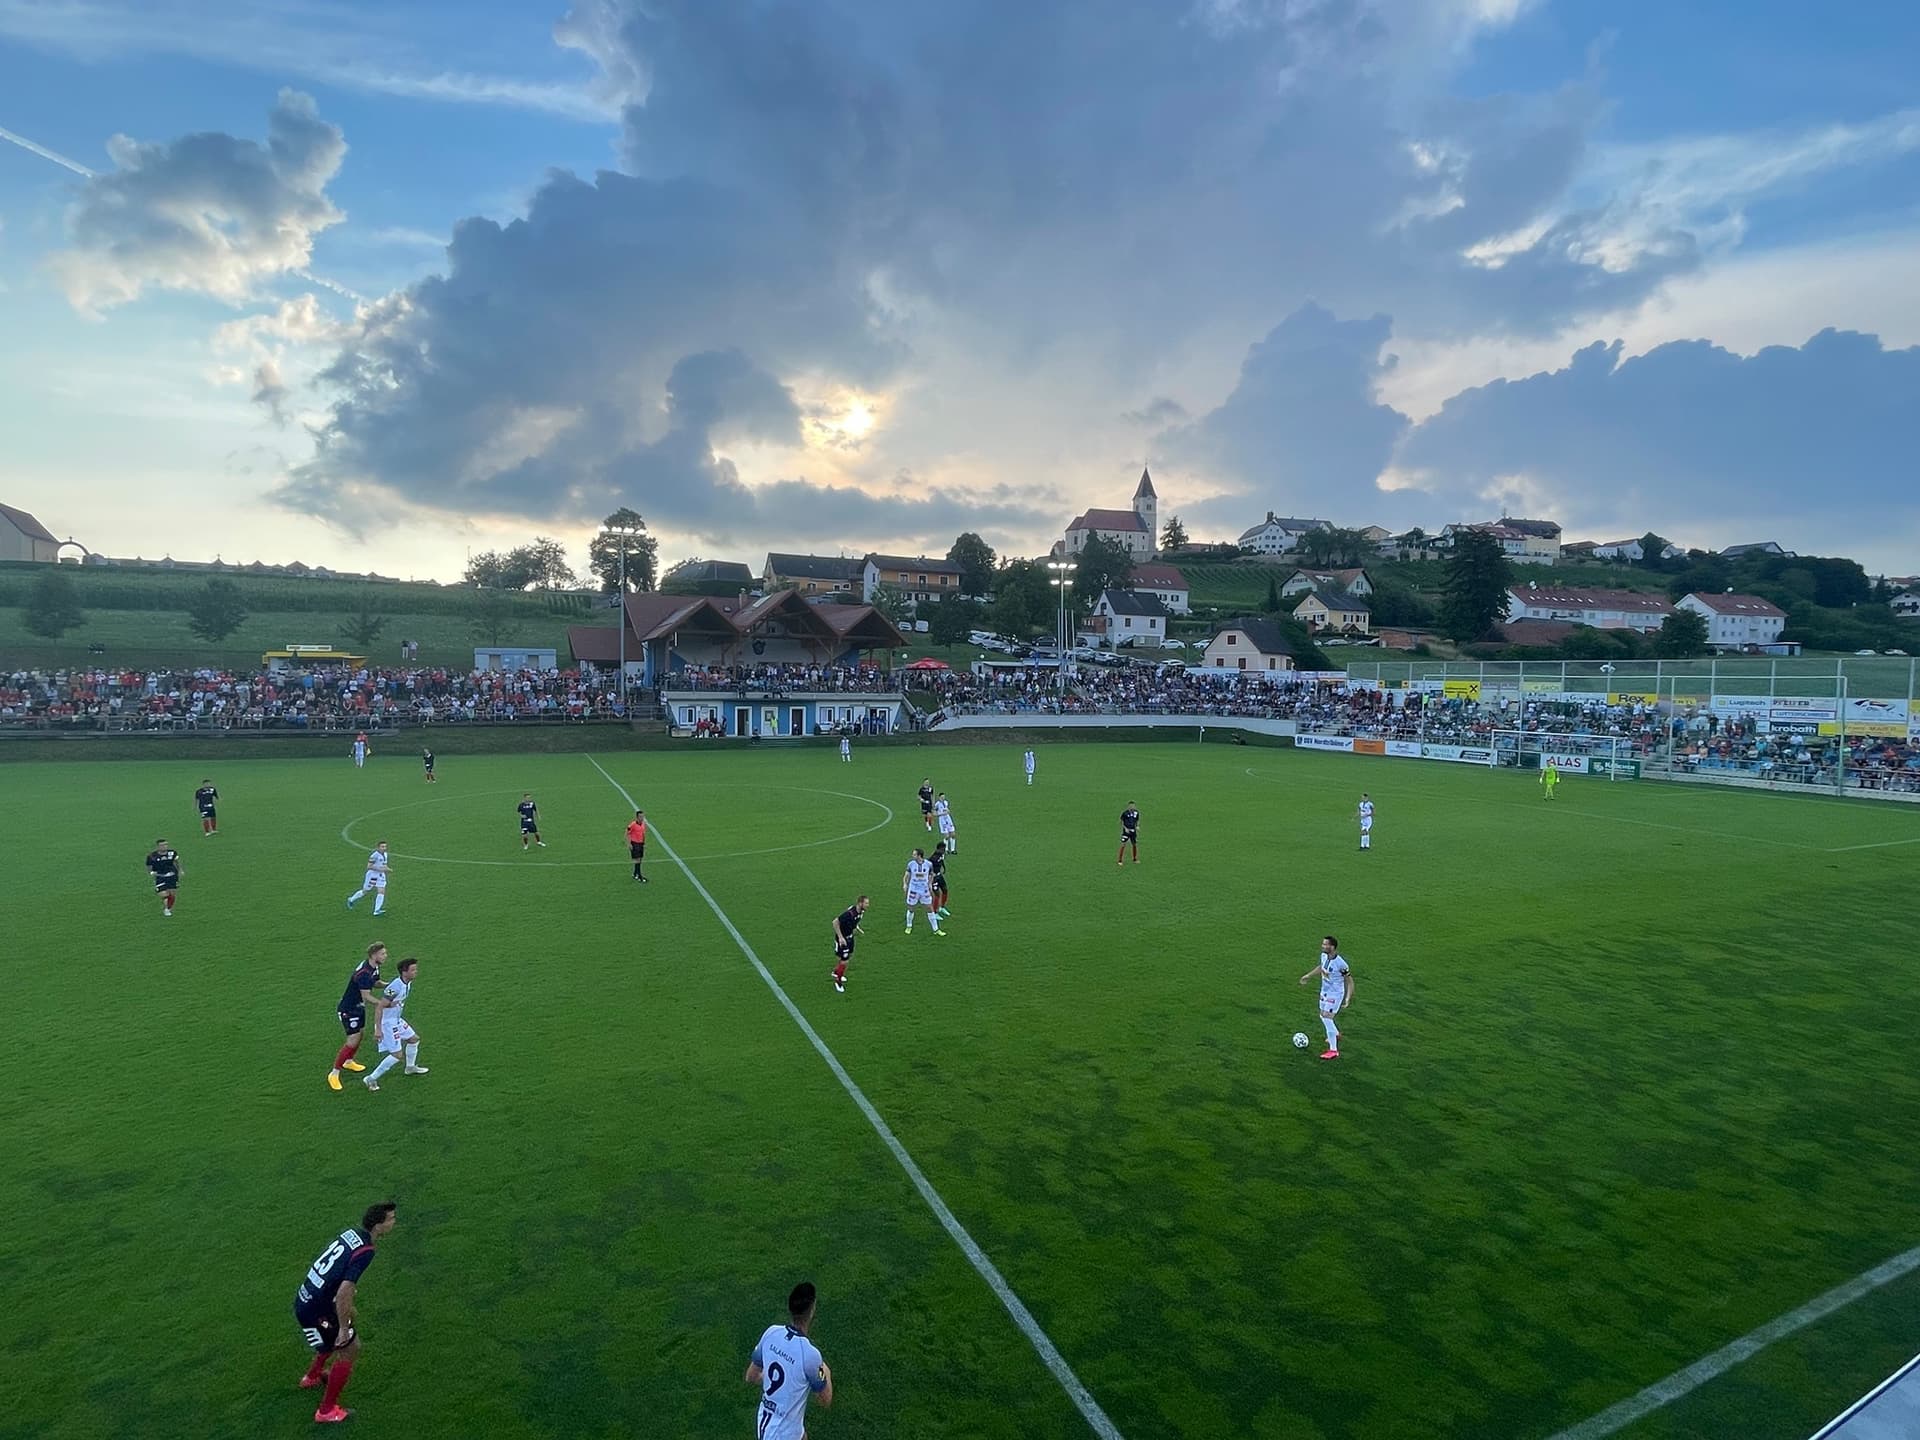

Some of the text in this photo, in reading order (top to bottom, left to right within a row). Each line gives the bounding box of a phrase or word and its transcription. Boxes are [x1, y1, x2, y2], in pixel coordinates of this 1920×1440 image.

[1618, 693, 1646, 704] Rex
[1771, 724, 1817, 733] krobath
[1547, 756, 1581, 768] ALAS
[766, 1361, 785, 1397] 9
